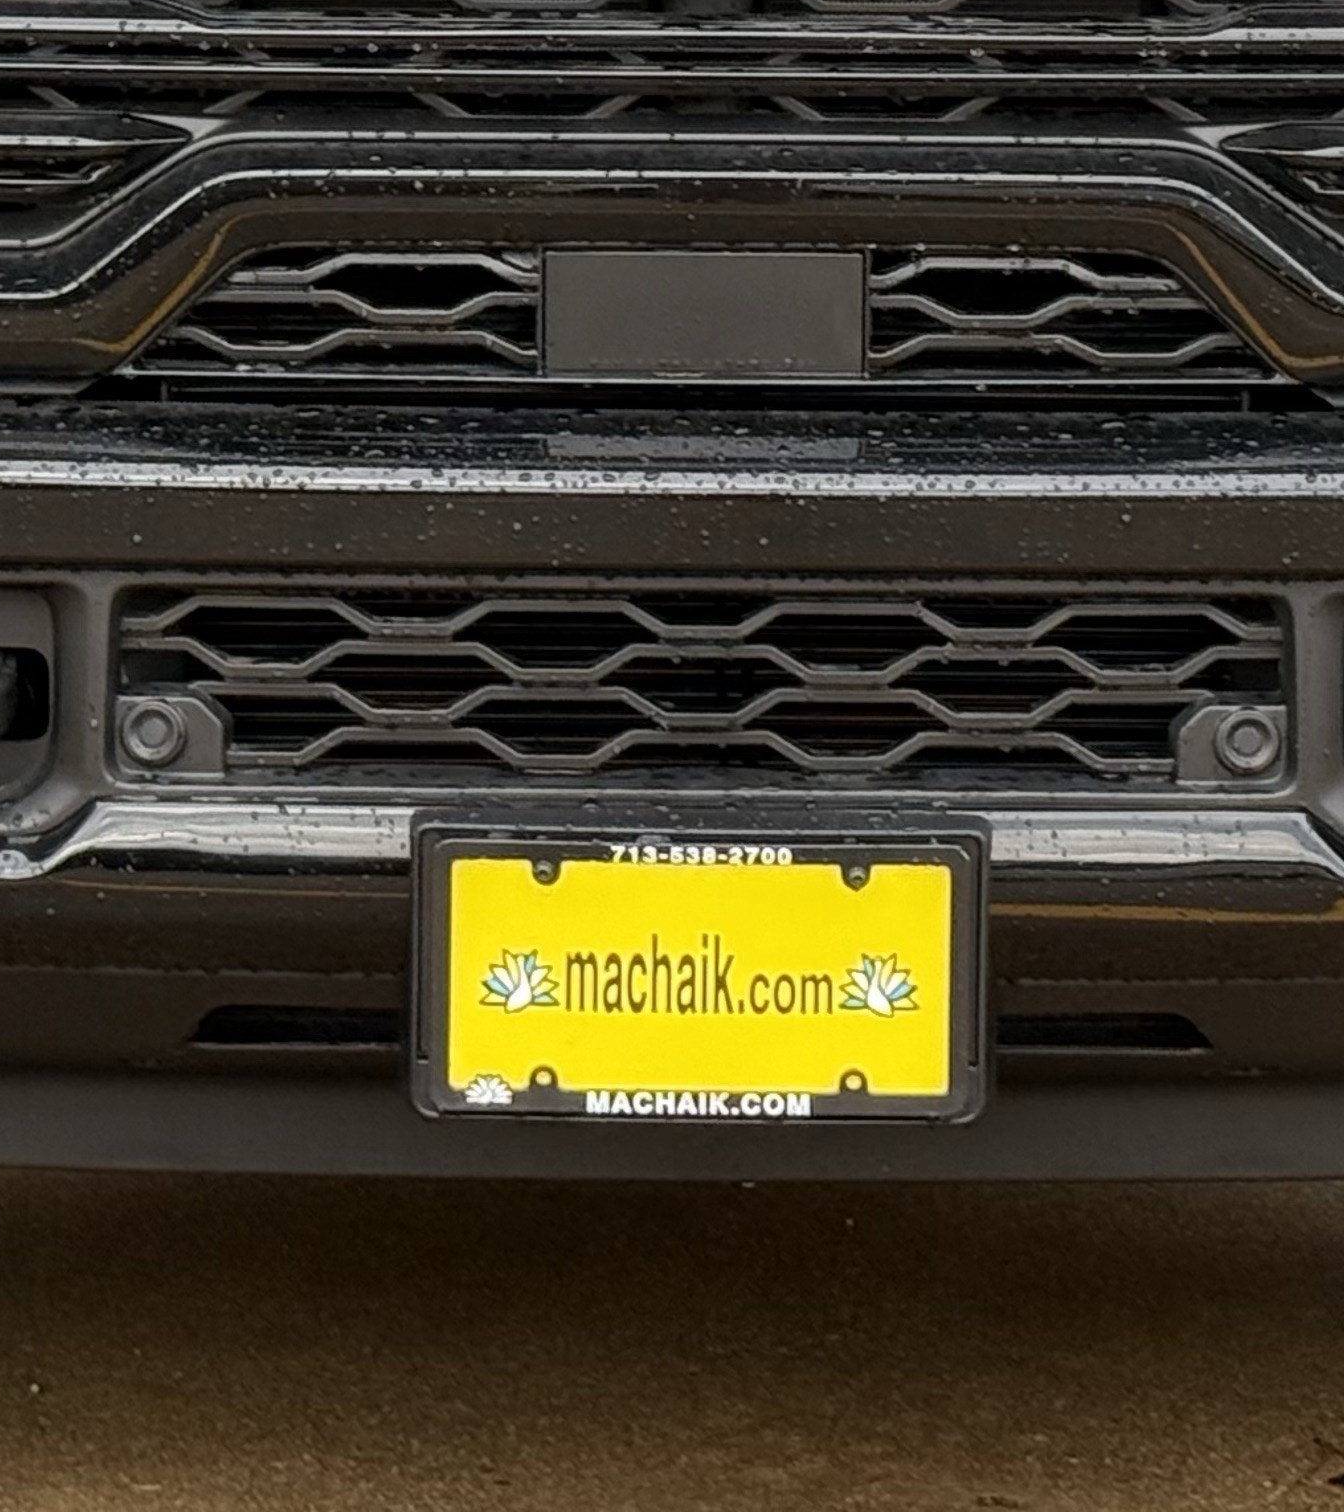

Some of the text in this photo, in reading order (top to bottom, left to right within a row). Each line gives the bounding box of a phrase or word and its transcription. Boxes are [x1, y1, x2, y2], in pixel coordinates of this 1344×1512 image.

[609, 845, 793, 865] 713-538-2700
[565, 933, 834, 1016] machaik.com
[585, 1090, 812, 1117] MACHAIK.COM
